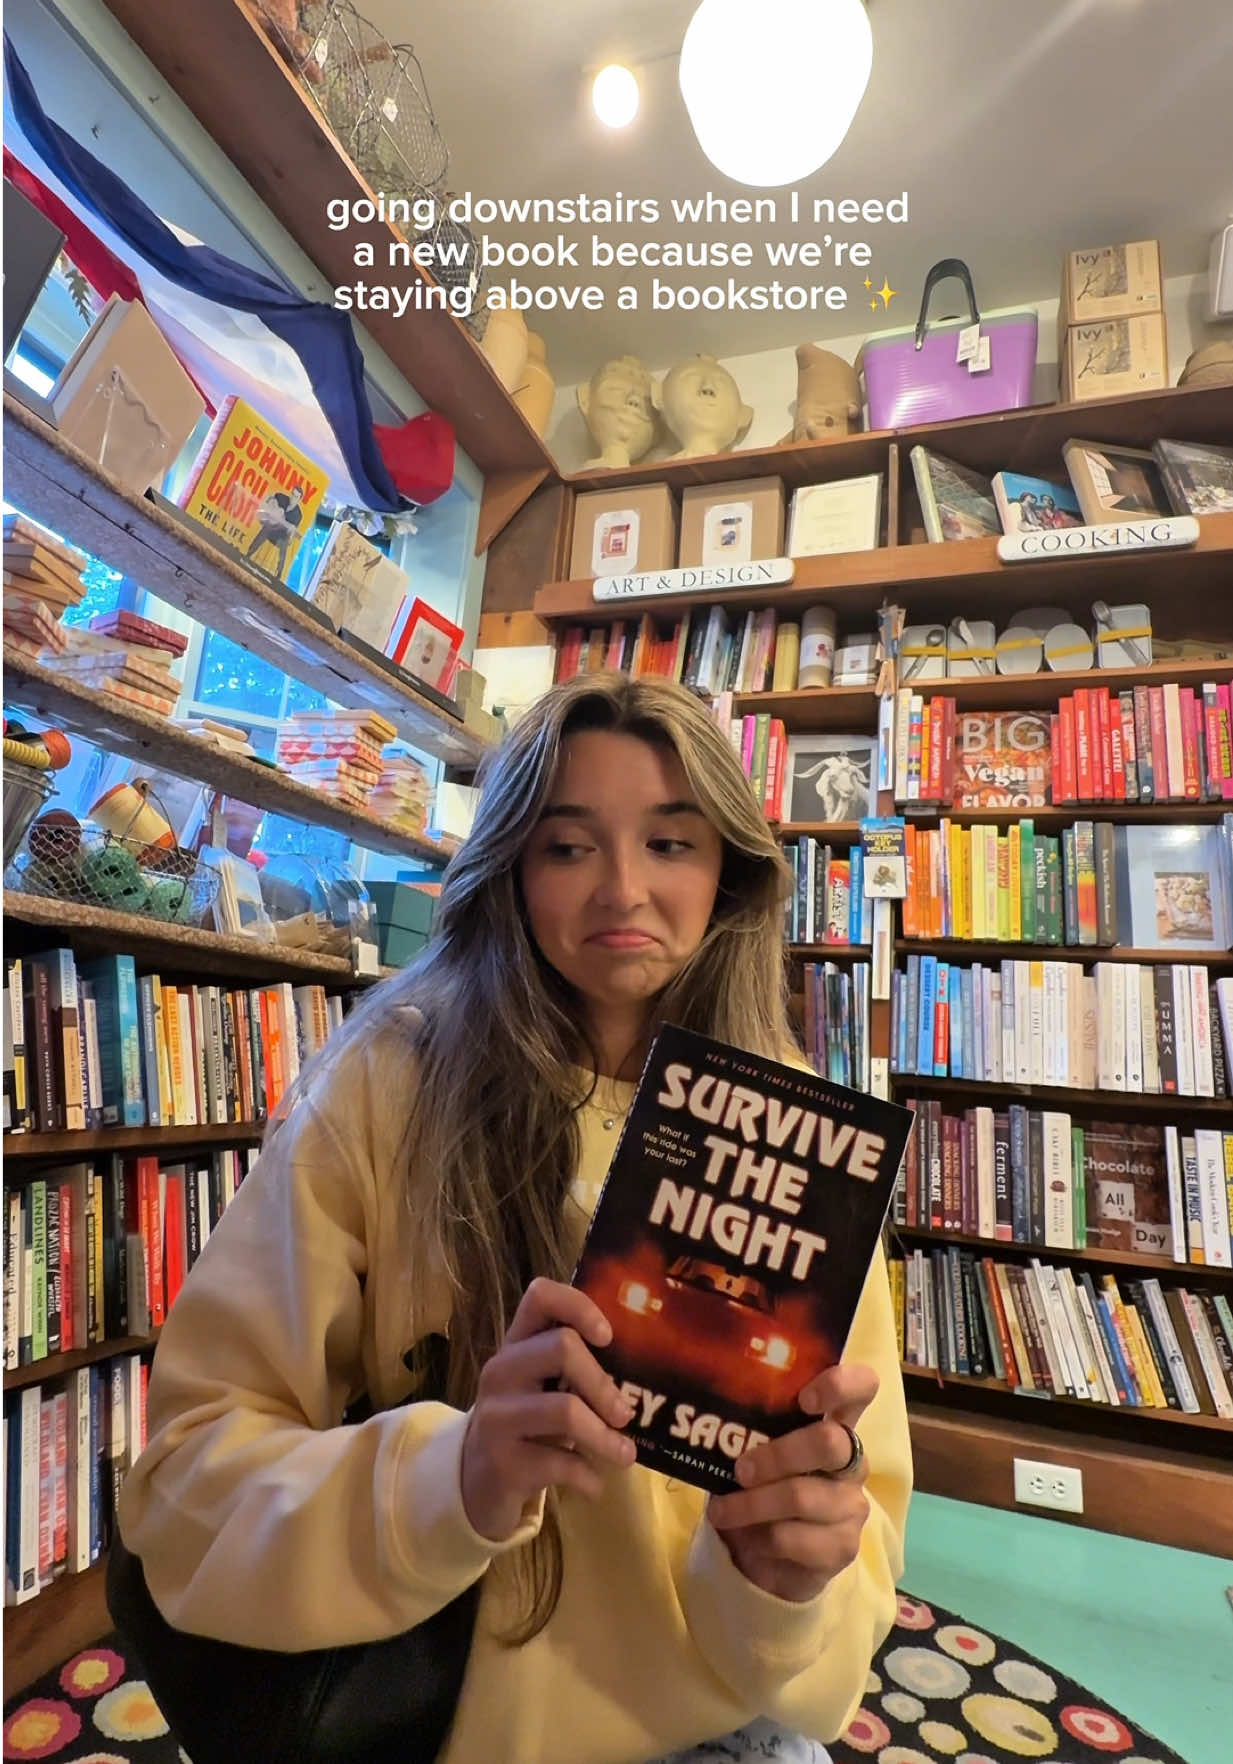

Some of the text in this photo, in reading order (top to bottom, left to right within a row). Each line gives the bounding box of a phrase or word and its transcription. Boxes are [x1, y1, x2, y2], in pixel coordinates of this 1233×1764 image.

[1075, 253, 1099, 266] Ivy
[1076, 328, 1102, 341] Ivy
[233, 427, 317, 504] JOHNNY
[199, 503, 249, 546] THE LIFE
[1020, 523, 1173, 555] COOKING
[606, 564, 775, 595] ART & DESIGN
[963, 716, 1045, 753] BIG
[963, 764, 1044, 787] Vegan
[1034, 848, 1048, 888] peckish
[1208, 1008, 1224, 1085] BACKYARD PIZZA
[704, 1052, 855, 1112] NEW YORK TIMES BESTSELLER
[658, 1062, 886, 1183] SURVIVE
[658, 1124, 691, 1142] What if
[642, 1131, 697, 1159] this ride was
[644, 1147, 688, 1167] your last?
[704, 1135, 809, 1215] THE
[930, 1158, 942, 1202] CHOCOLATE
[996, 1141, 1010, 1200] ferment
[1083, 1157, 1155, 1176] Chocolate
[1105, 1193, 1125, 1206] All
[1185, 1156, 1202, 1223] TASTE IN MUSIC
[34, 1188, 44, 1264] LANDLINES
[47, 1191, 60, 1265] PROZAC NATION
[190, 1226, 198, 1251] CROW
[648, 1177, 827, 1281] NIGHT
[1136, 1231, 1166, 1249] Day
[6, 1233, 18, 1295] Educated
[620, 1380, 667, 1428] EY
[39, 1410, 51, 1478] WILDLAND
[54, 1399, 68, 1467] WILDLAND
[38, 1488, 51, 1521] EVAN
[54, 1476, 68, 1510] EVAN
